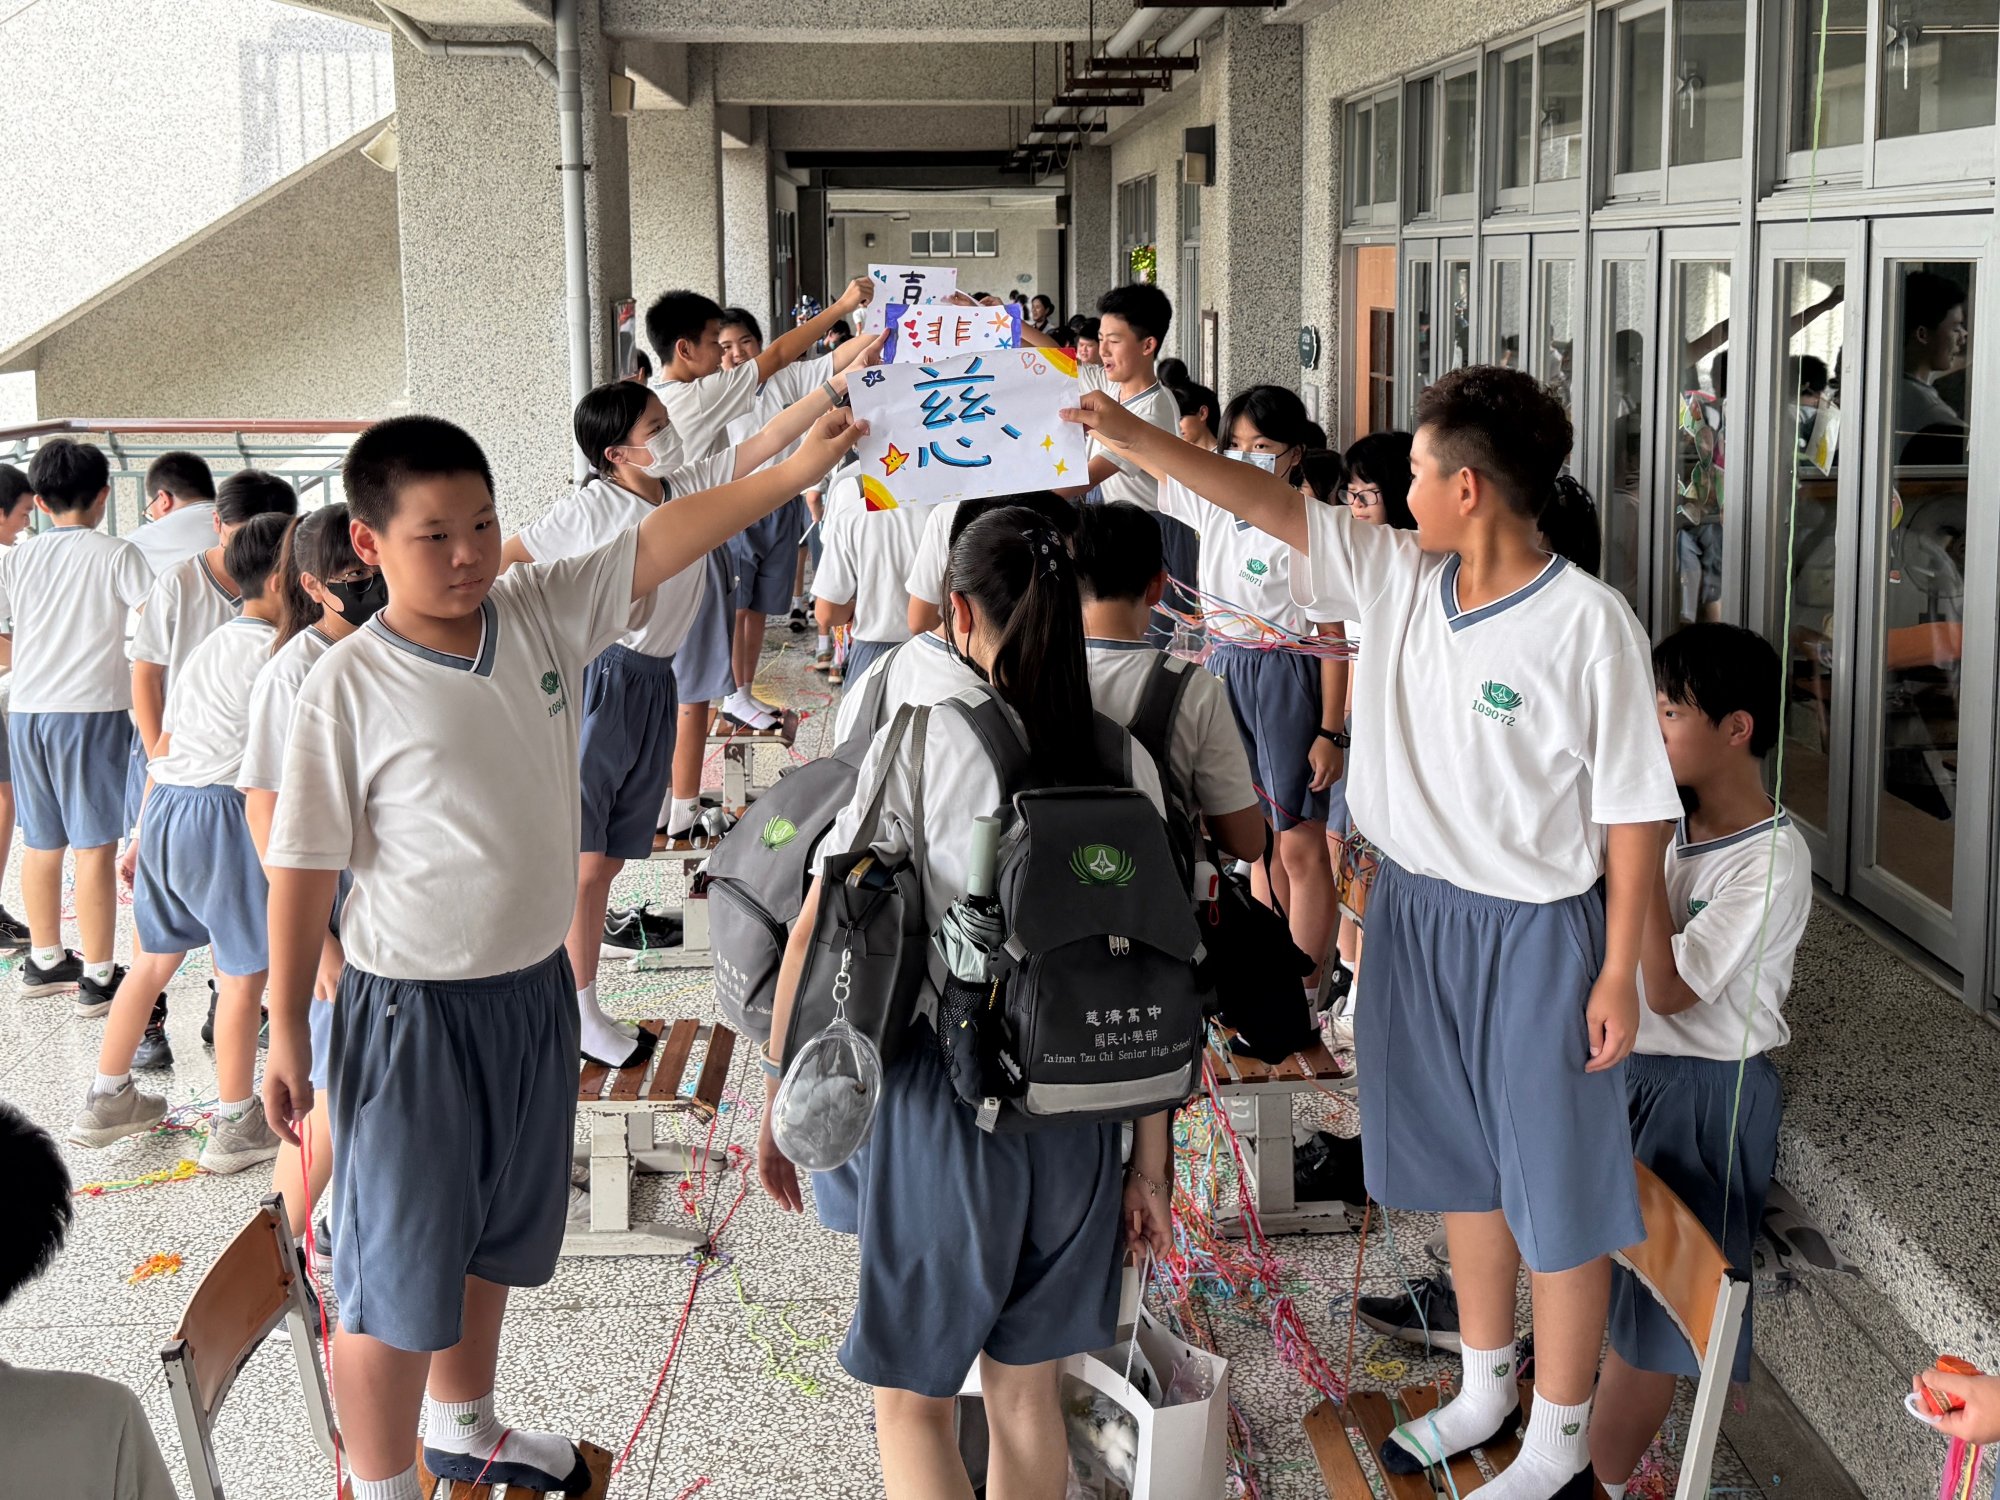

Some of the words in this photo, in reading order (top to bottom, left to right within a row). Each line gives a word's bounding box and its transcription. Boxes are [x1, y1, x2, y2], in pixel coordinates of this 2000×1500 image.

[913, 356, 1022, 468] 慈
[1471, 699, 1516, 727] 109072
[1085, 1004, 1162, 1027] 慈濟高中
[1095, 1029, 1158, 1048] 國民小學部
[1043, 1053, 1076, 1063] Tainan
[1080, 1052, 1096, 1063] Tzu
[1099, 1051, 1114, 1062] Chi
[1118, 1049, 1147, 1060] Senior
[1151, 1045, 1169, 1057] High
